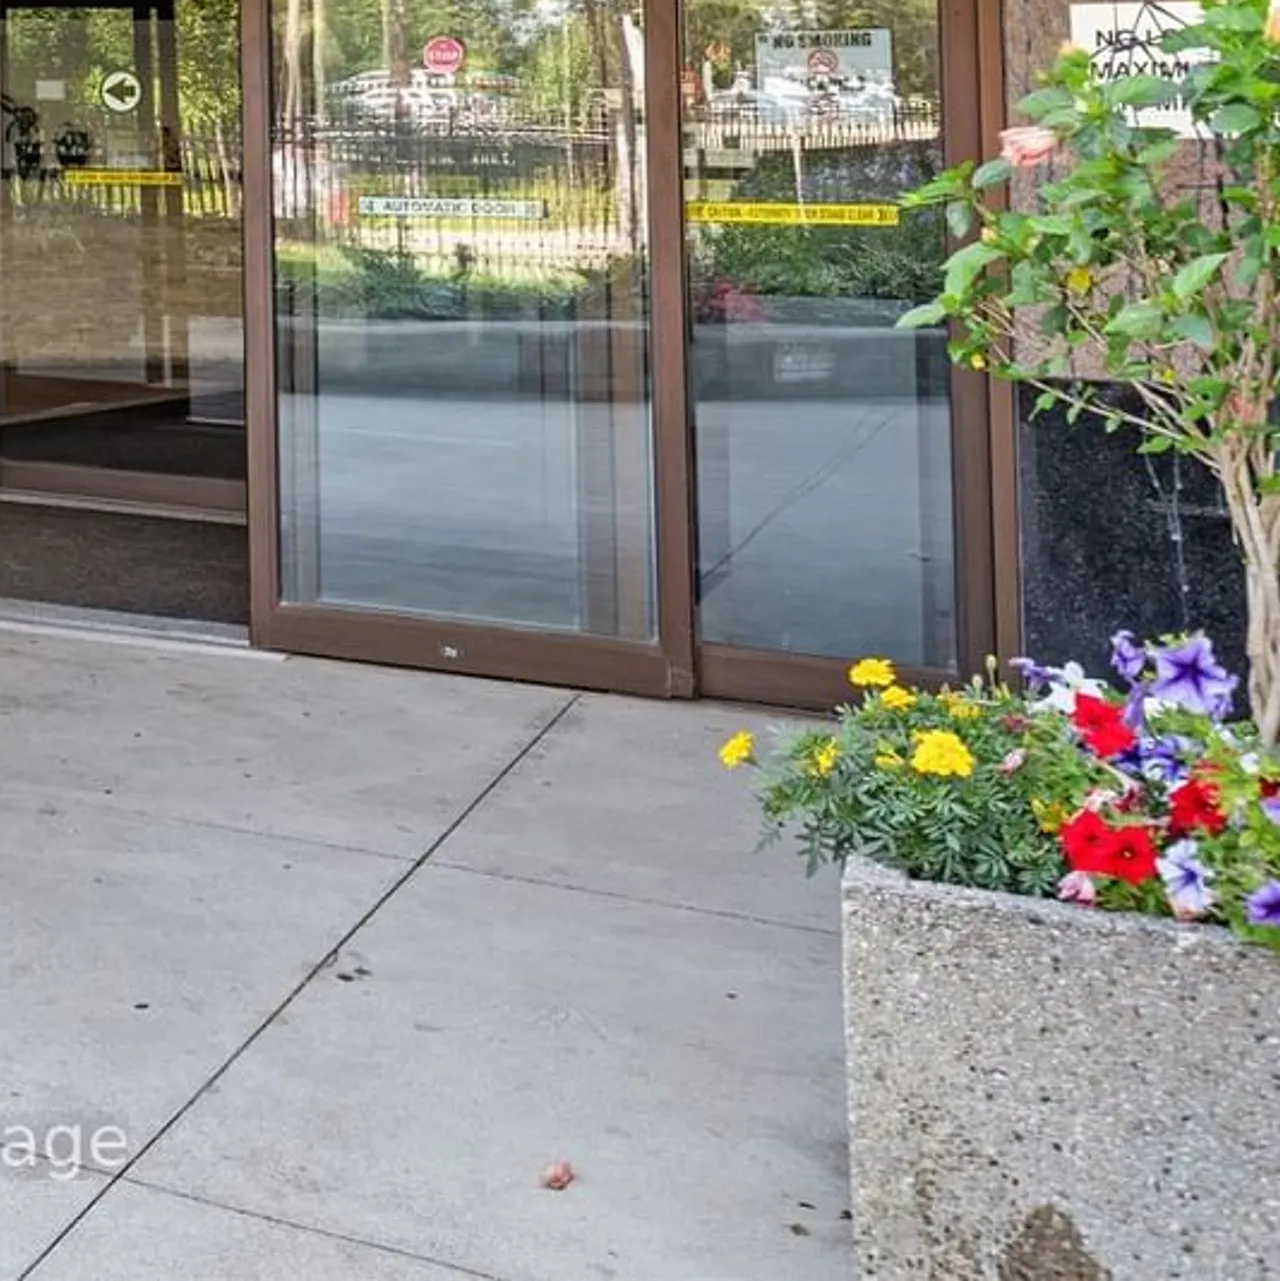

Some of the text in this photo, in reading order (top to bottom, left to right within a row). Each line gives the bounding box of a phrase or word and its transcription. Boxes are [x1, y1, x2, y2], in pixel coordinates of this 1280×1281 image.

[773, 32, 872, 48] NO SMOKING
[383, 200, 468, 213] AUTOMATIC
